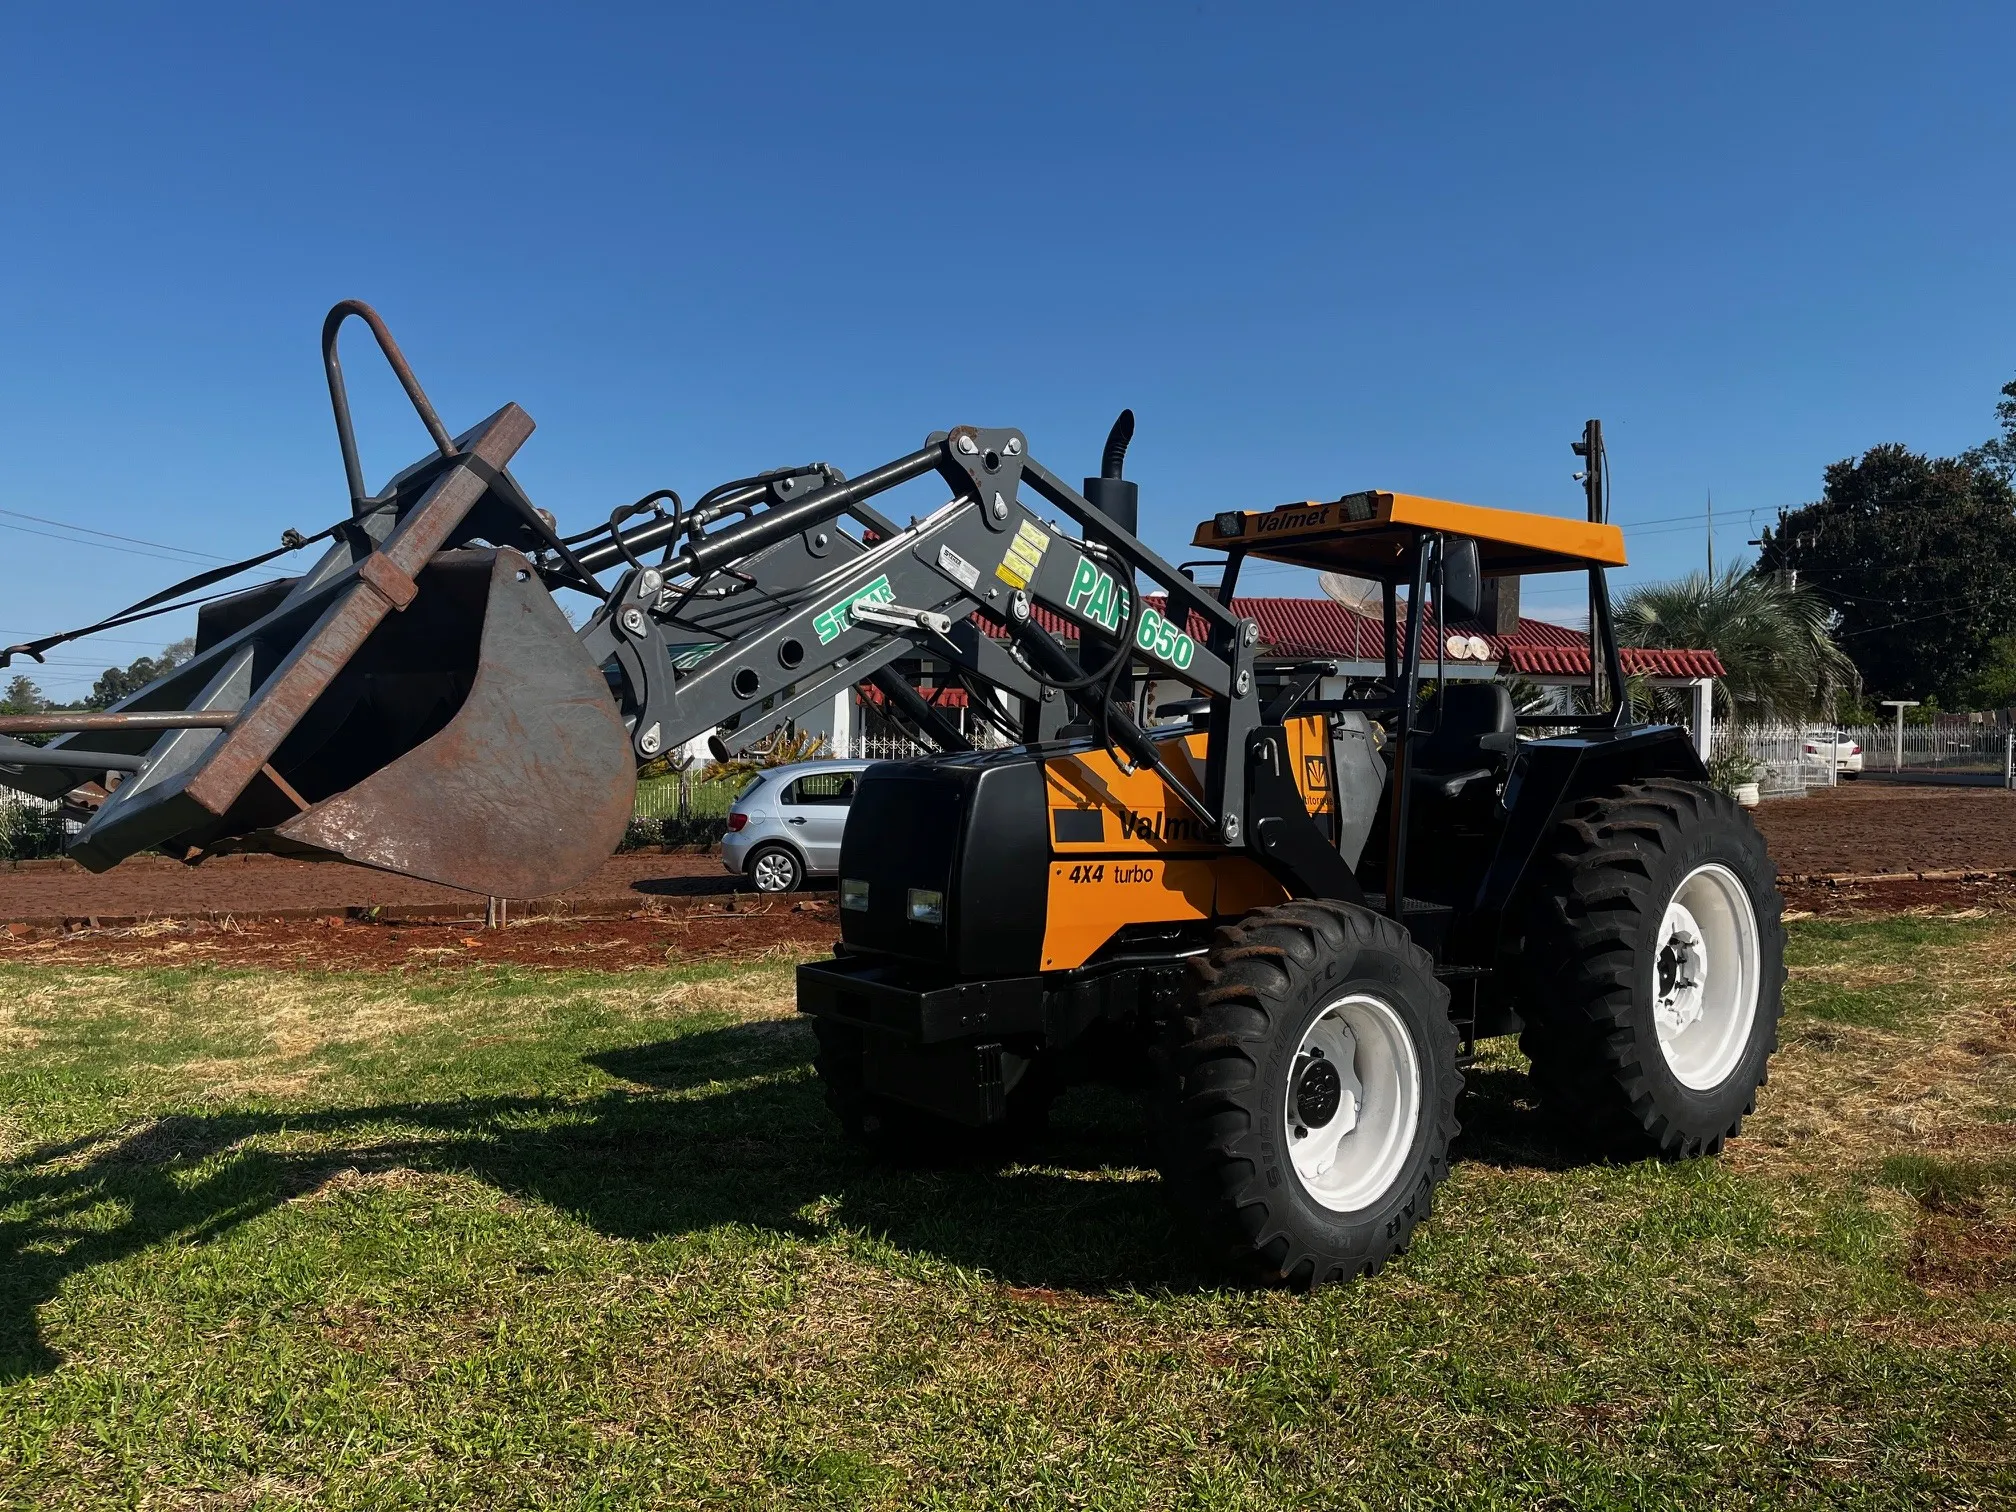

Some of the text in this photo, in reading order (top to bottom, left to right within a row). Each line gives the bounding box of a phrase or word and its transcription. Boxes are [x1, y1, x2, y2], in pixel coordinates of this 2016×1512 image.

[1257, 507, 1330, 532] Valmet
[812, 574, 896, 647] STAR
[1066, 555, 1130, 632] PAF
[1137, 608, 1194, 669] 650
[1069, 865, 1153, 884] 4X4 turbo
[1297, 962, 1337, 1006] TFC
